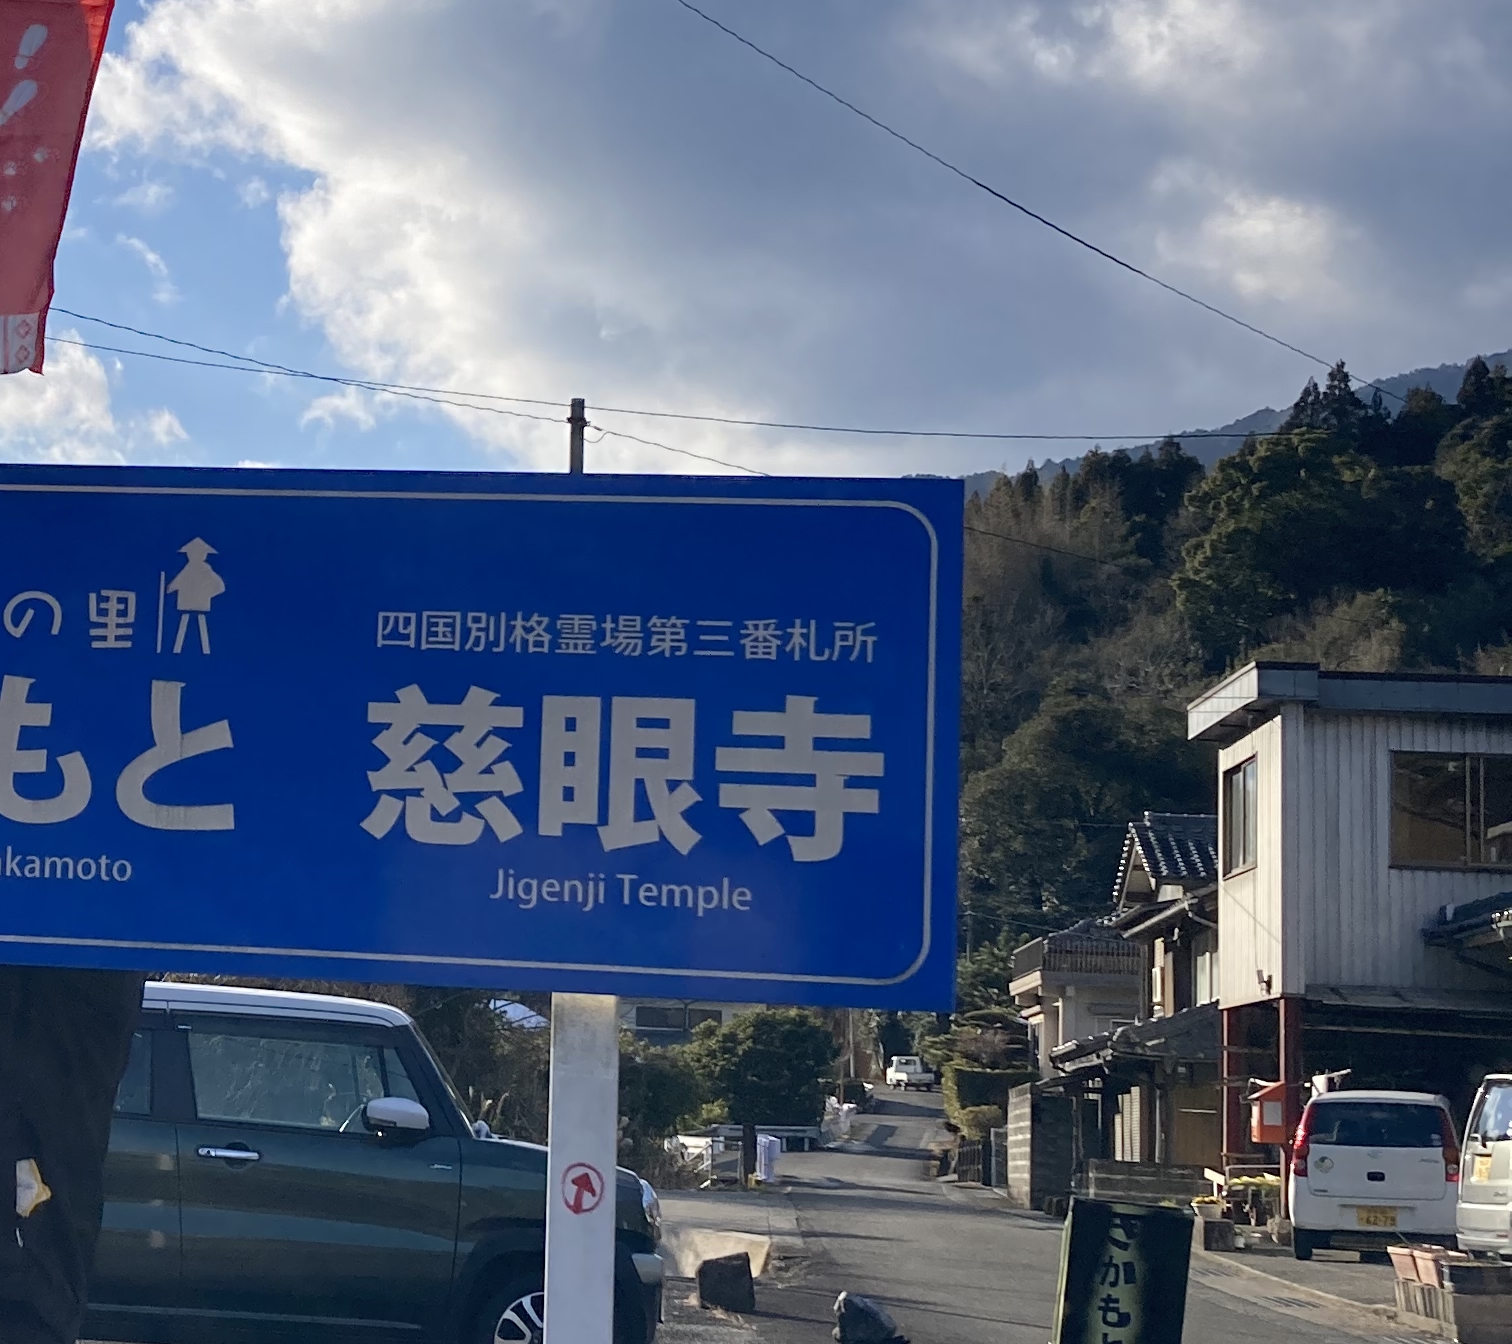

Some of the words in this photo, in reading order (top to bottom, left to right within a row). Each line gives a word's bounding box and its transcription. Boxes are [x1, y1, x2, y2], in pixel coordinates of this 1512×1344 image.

[376, 610, 879, 664] 四国別格霊場第三番札所
[358, 683, 885, 863] 慈眼寺
[488, 867, 606, 913] Jigenji
[615, 873, 753, 918] Temple
